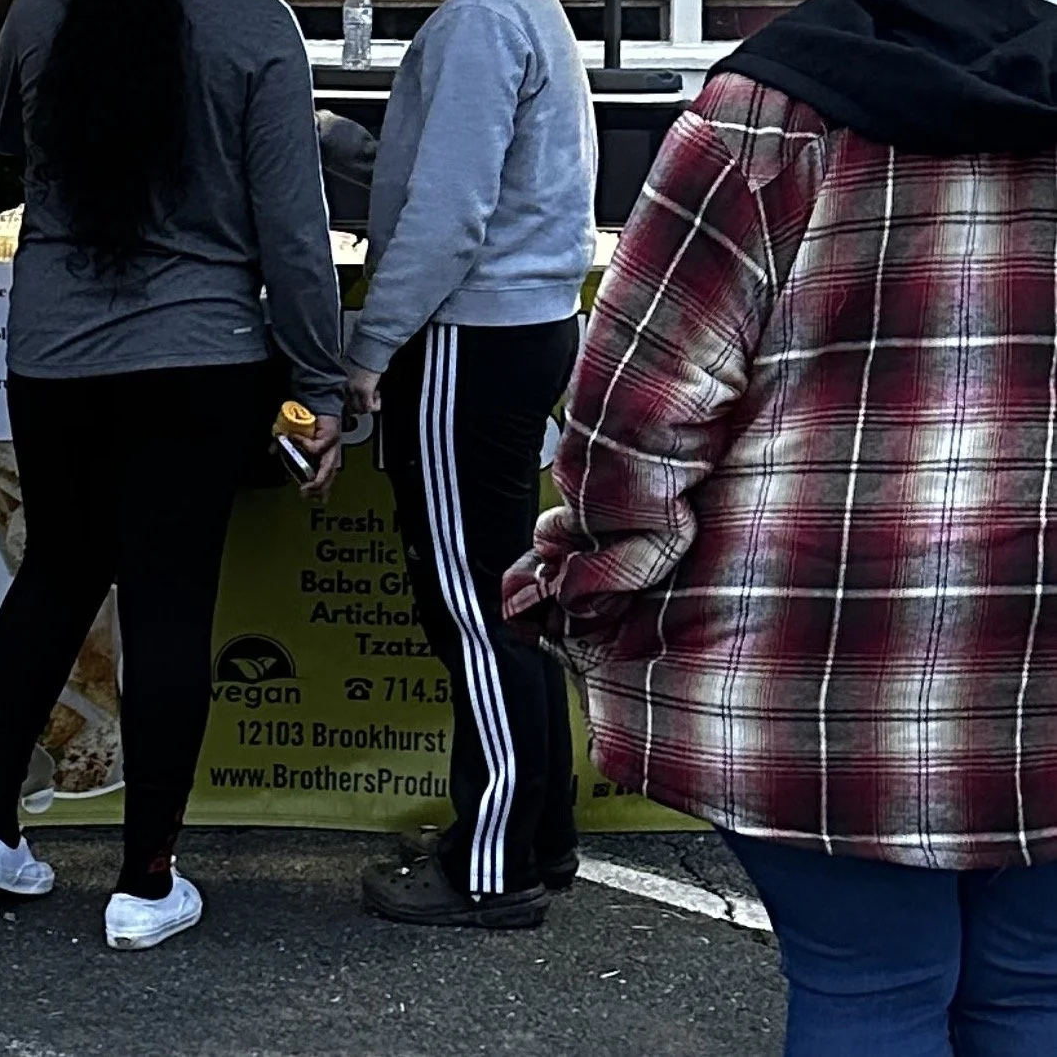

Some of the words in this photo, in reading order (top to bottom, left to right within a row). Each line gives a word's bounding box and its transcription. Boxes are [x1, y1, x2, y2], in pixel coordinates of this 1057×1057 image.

[310, 508, 384, 533] Fresh
[316, 539, 398, 565] Garlic
[301, 570, 372, 595] Baba
[210, 685, 301, 709] vegan
[383, 677, 453, 703] 714.5
[237, 720, 304, 746] 12103
[312, 723, 446, 753] Brookhurst
[210, 763, 447, 798] www.BrothersProdu
